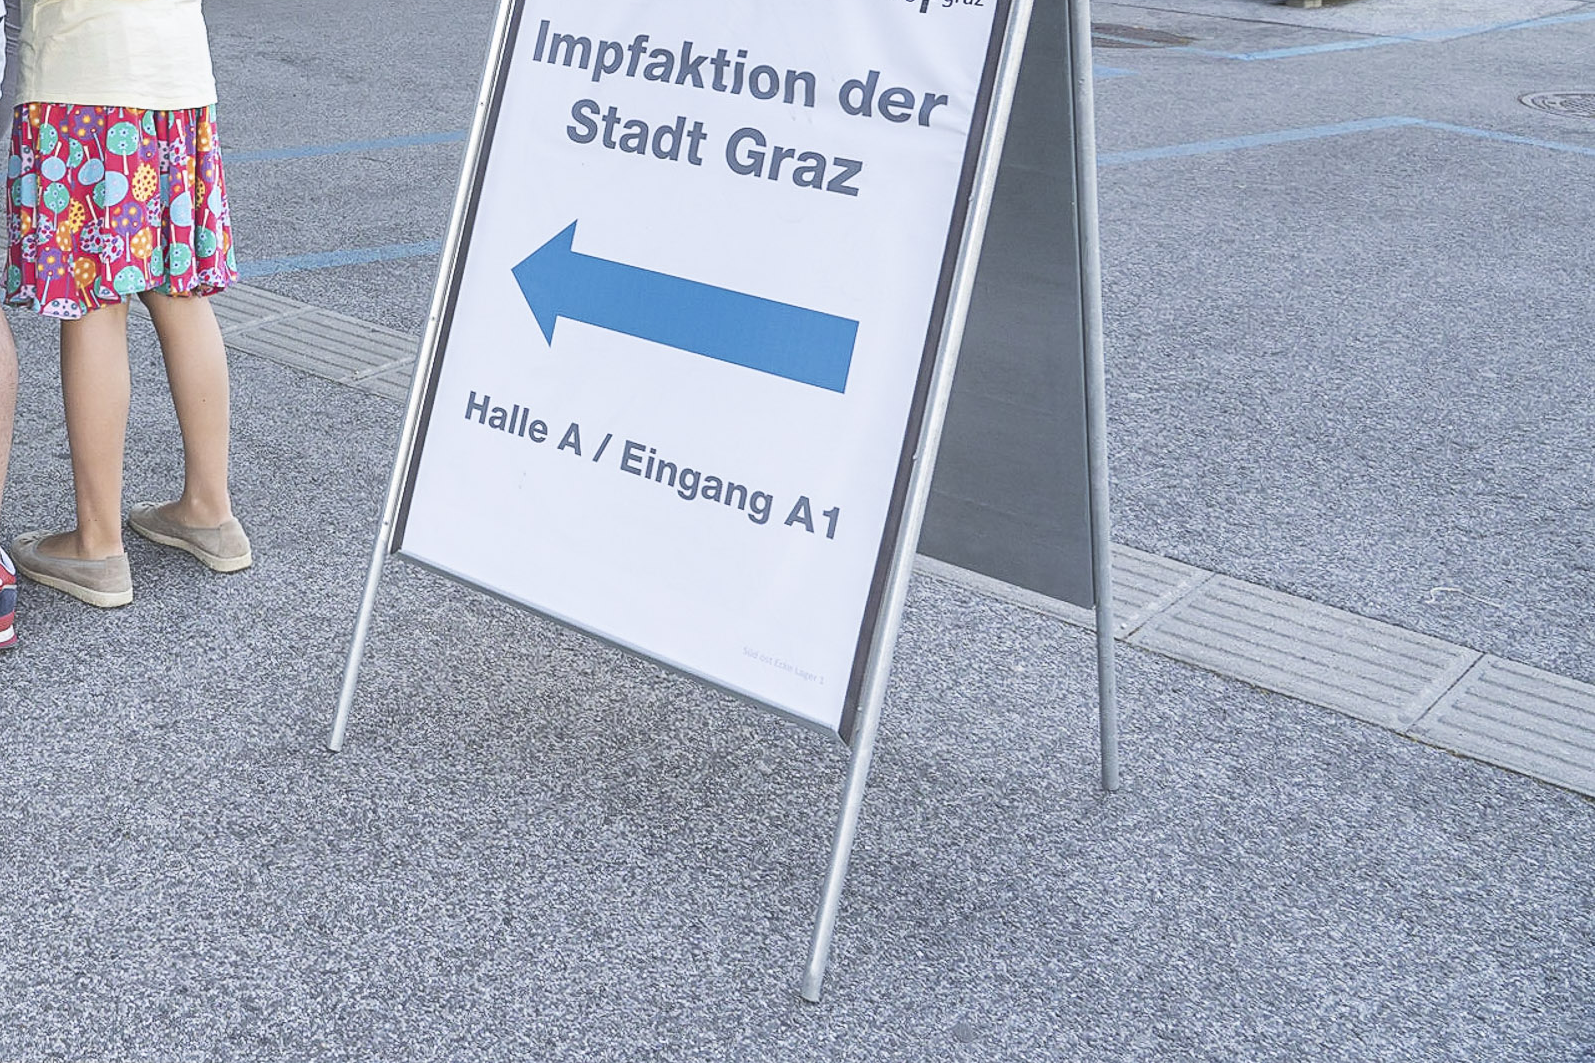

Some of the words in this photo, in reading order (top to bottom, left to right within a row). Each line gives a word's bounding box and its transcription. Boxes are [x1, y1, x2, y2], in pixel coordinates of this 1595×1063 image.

[532, 19, 816, 108] Impfaktion
[838, 69, 949, 128] der
[566, 98, 708, 167] Stadt
[725, 127, 864, 198] Graz
[464, 390, 548, 444] Halle
[556, 422, 583, 457] A
[592, 433, 613, 464] /
[620, 439, 774, 525] Eingang
[783, 495, 840, 540] A1
